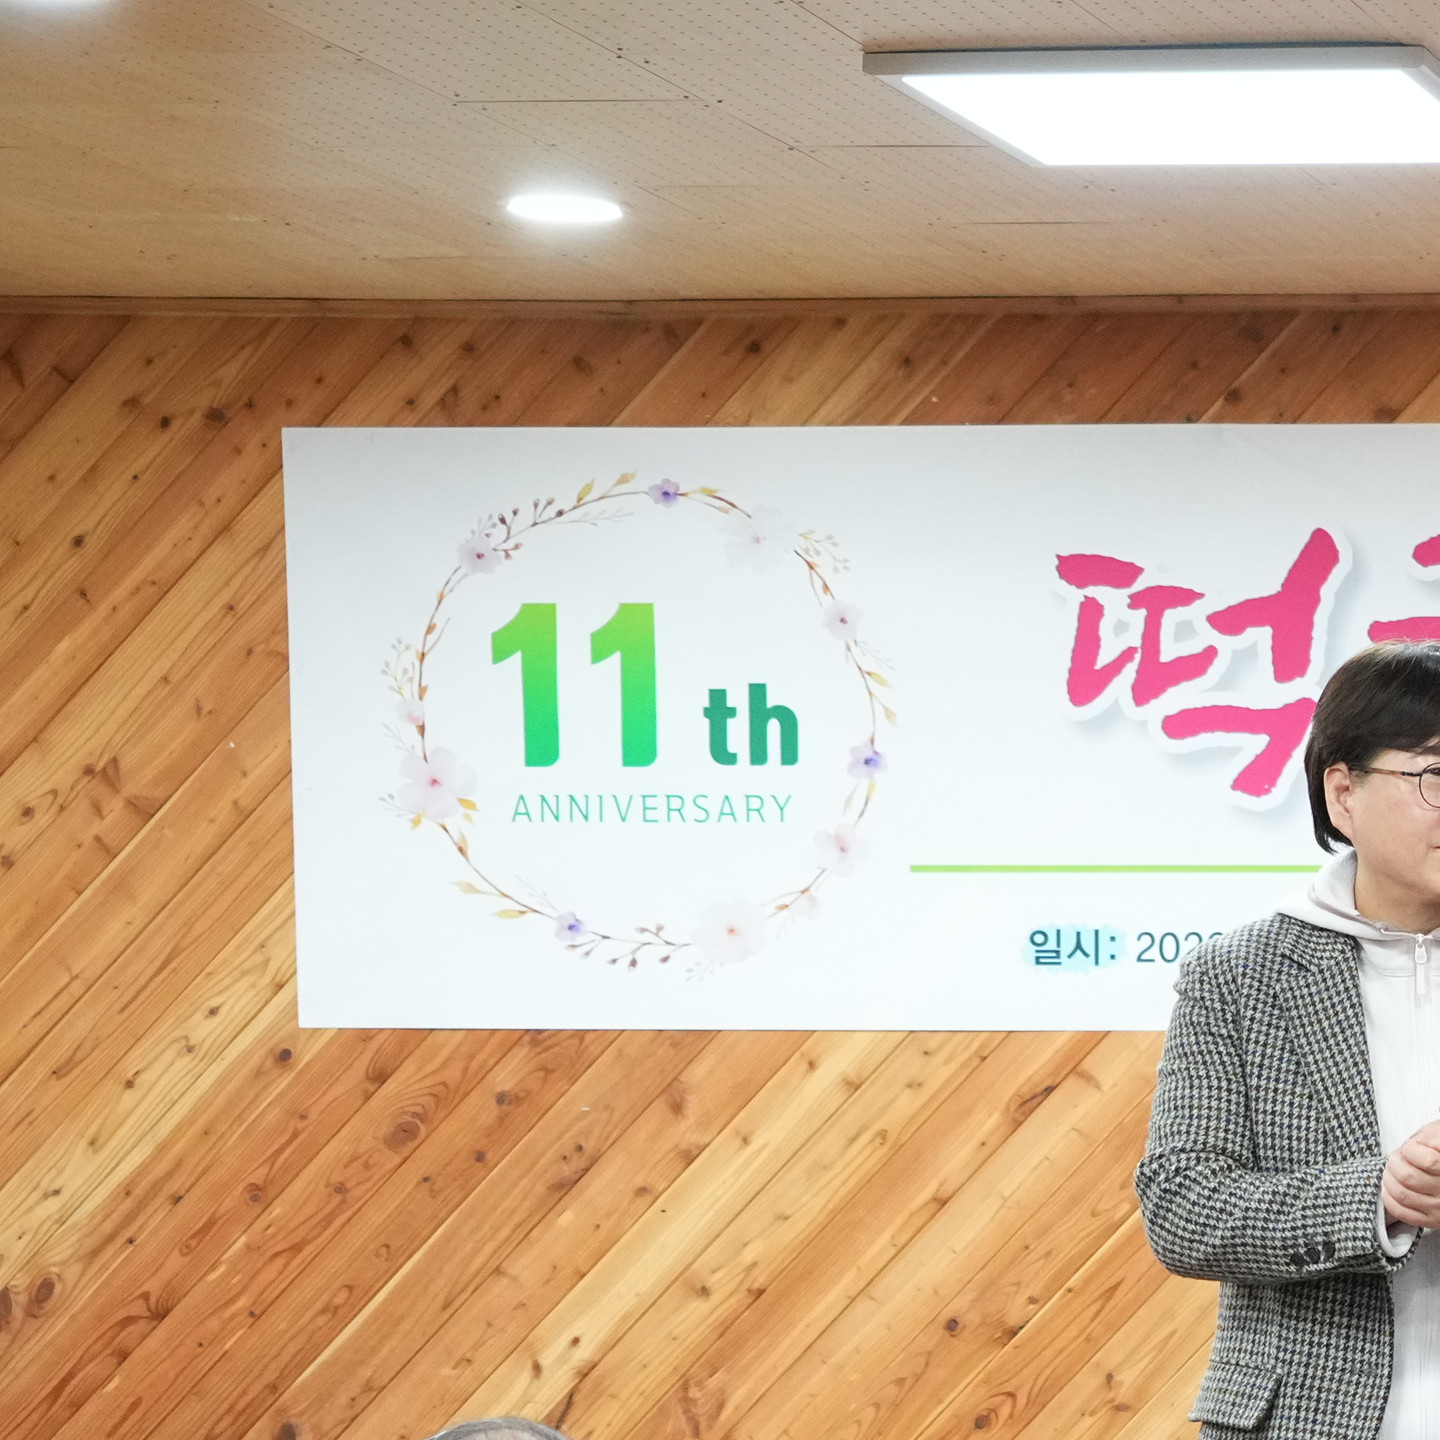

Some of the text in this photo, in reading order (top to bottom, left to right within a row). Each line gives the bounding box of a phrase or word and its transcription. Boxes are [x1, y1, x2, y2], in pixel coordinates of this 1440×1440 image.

[511, 793, 793, 824] ANNIVERSARY
[1029, 929, 1223, 966] 일시: 202
